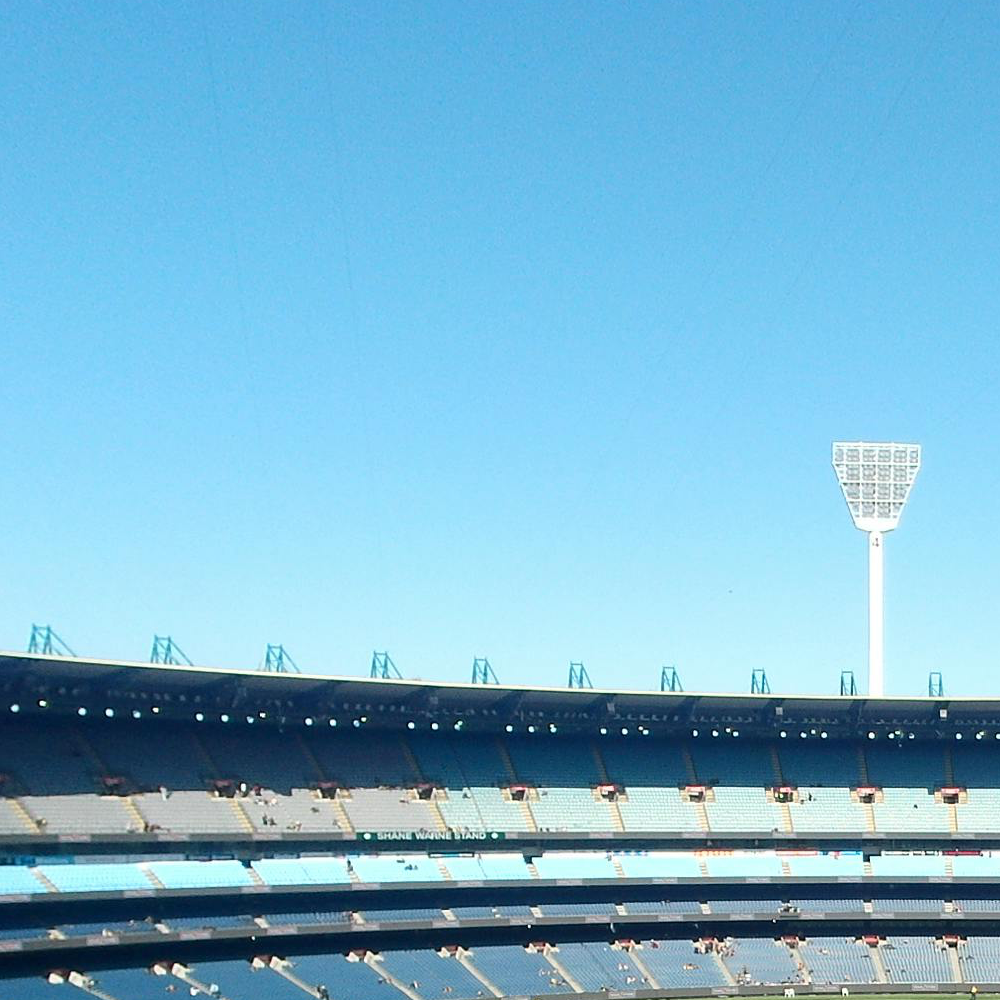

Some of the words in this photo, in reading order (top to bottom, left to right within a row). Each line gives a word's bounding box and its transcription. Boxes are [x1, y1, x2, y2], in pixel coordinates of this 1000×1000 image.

[377, 831, 412, 840] SHANE
[415, 831, 452, 840] WARNE
[454, 831, 486, 840] STAND
